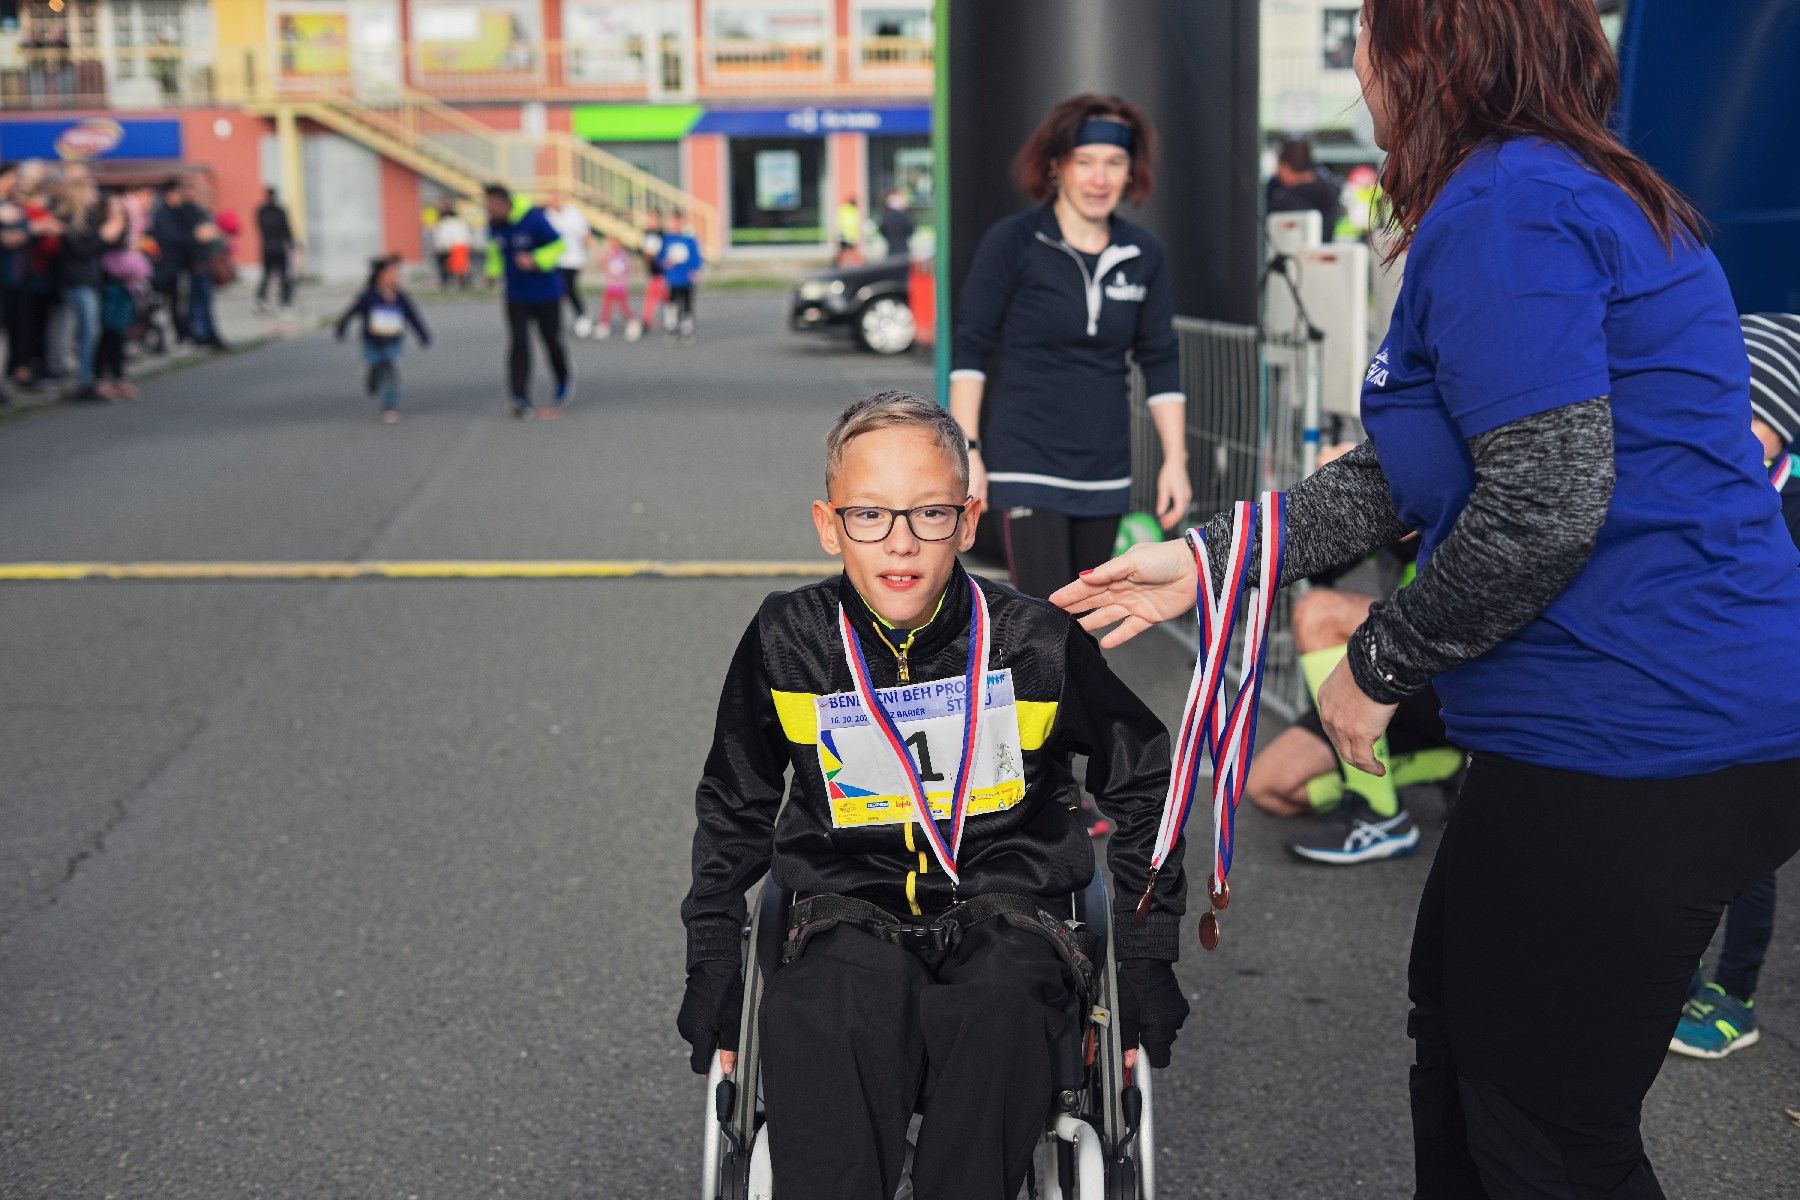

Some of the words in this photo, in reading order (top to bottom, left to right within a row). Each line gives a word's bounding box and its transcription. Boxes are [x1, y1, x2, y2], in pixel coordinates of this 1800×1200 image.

[902, 686, 931, 702] BĚH
[936, 681, 966, 696] PRO
[897, 708, 926, 718] BARIÉR
[904, 731, 944, 782] 1
